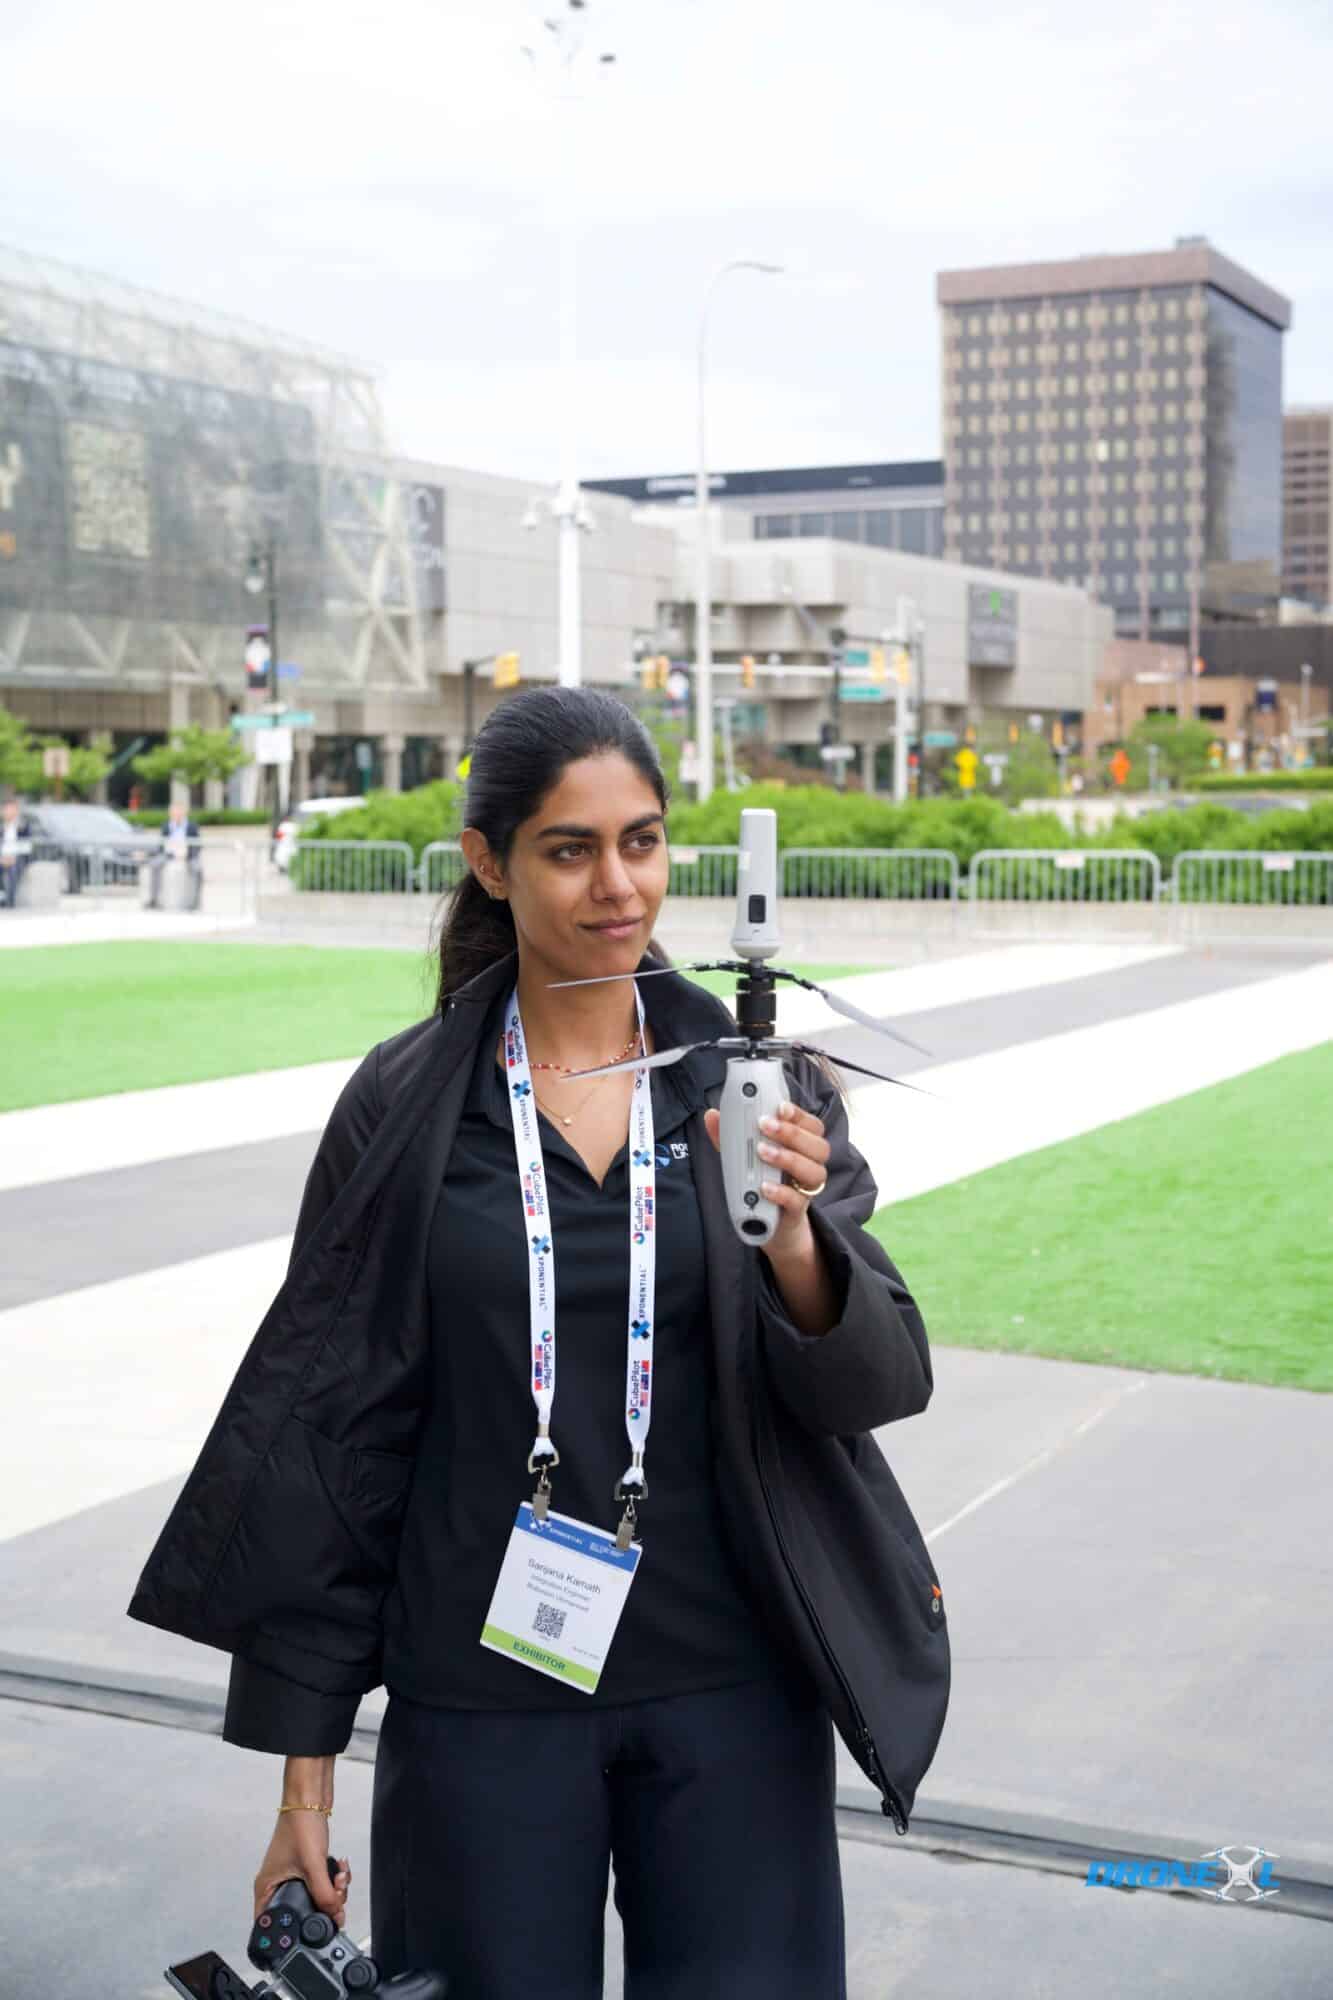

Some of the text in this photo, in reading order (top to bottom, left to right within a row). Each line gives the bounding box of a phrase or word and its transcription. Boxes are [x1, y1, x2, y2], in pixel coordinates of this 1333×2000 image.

[532, 1173, 544, 1215] CubePilot
[634, 1187, 643, 1231] CubePilot
[537, 1257, 546, 1306] XPONENTIAL
[639, 1269, 647, 1318] XPONENTIAL
[543, 1344, 552, 1390] CubePilot
[631, 1360, 640, 1407] CubePilot
[513, 1641, 565, 1671] EXHIBITOR
